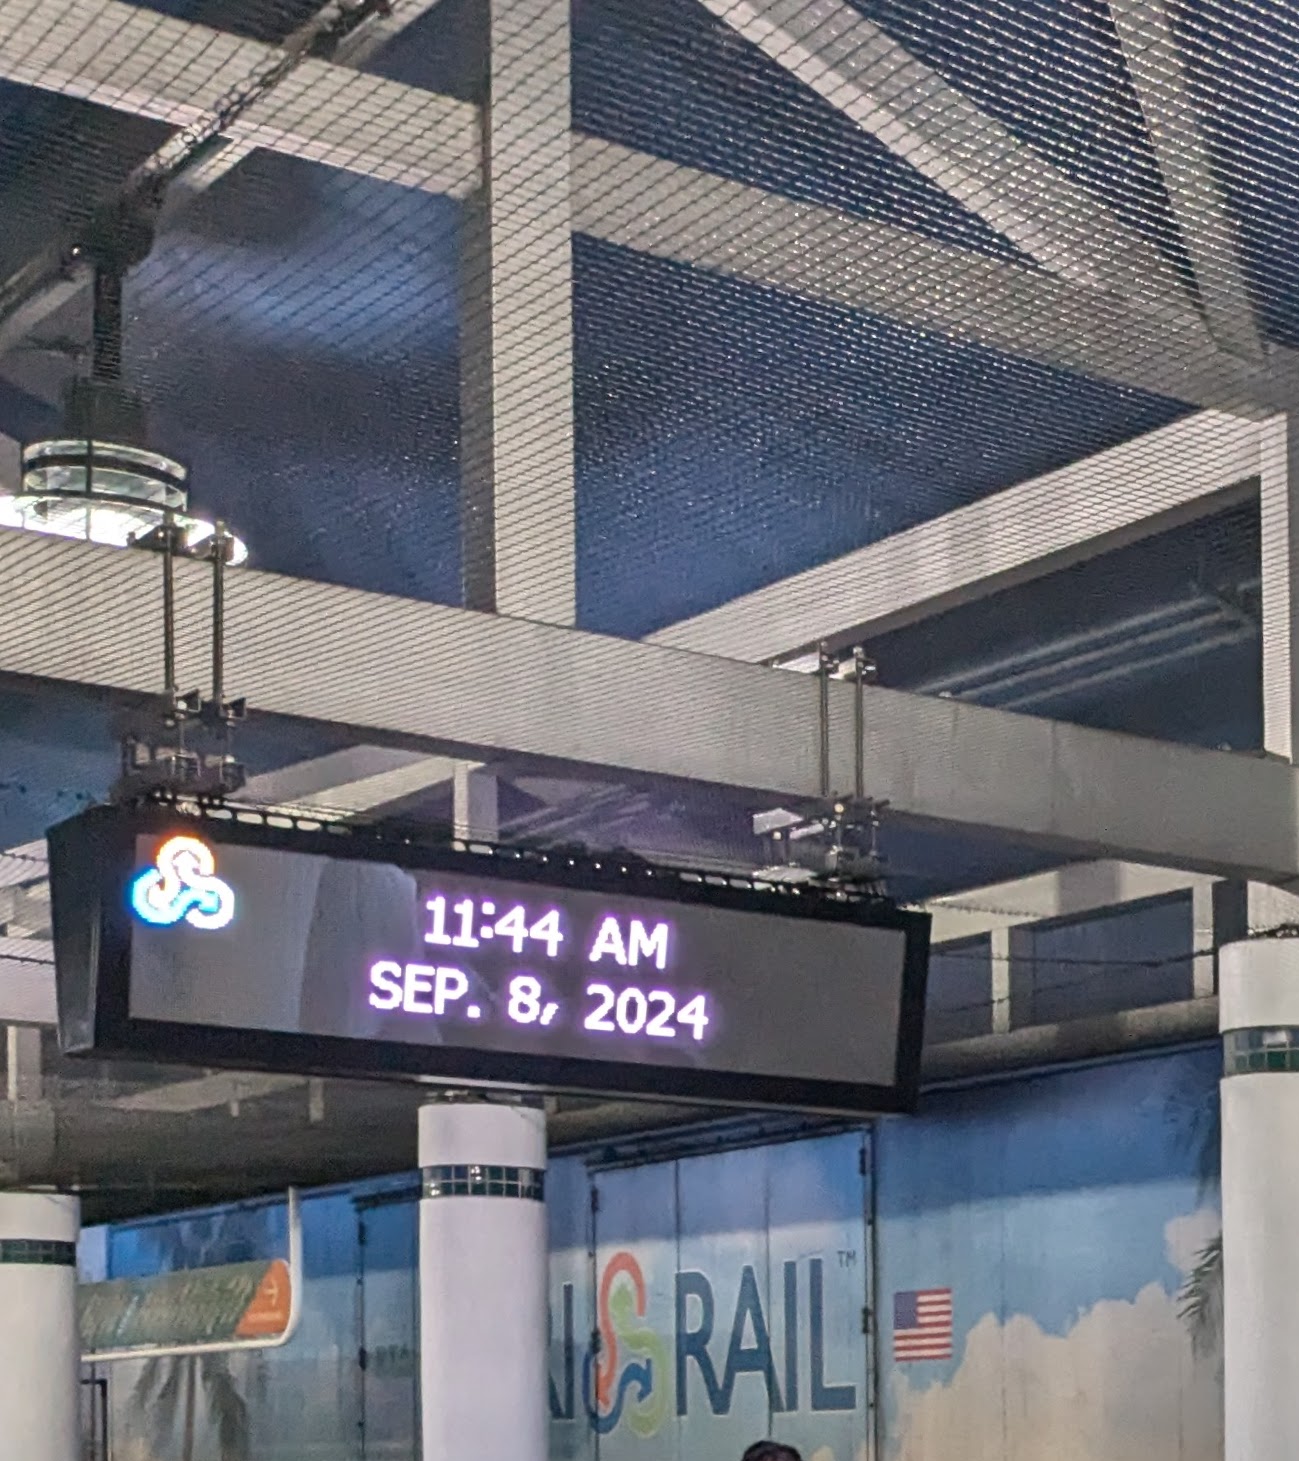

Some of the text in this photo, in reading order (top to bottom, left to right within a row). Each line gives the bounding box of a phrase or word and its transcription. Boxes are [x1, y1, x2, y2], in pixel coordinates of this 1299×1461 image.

[423, 895, 669, 971] 11:44 AM
[369, 961, 709, 1041] SEP. 8, 2024
[675, 1257, 857, 1417] RAIL
